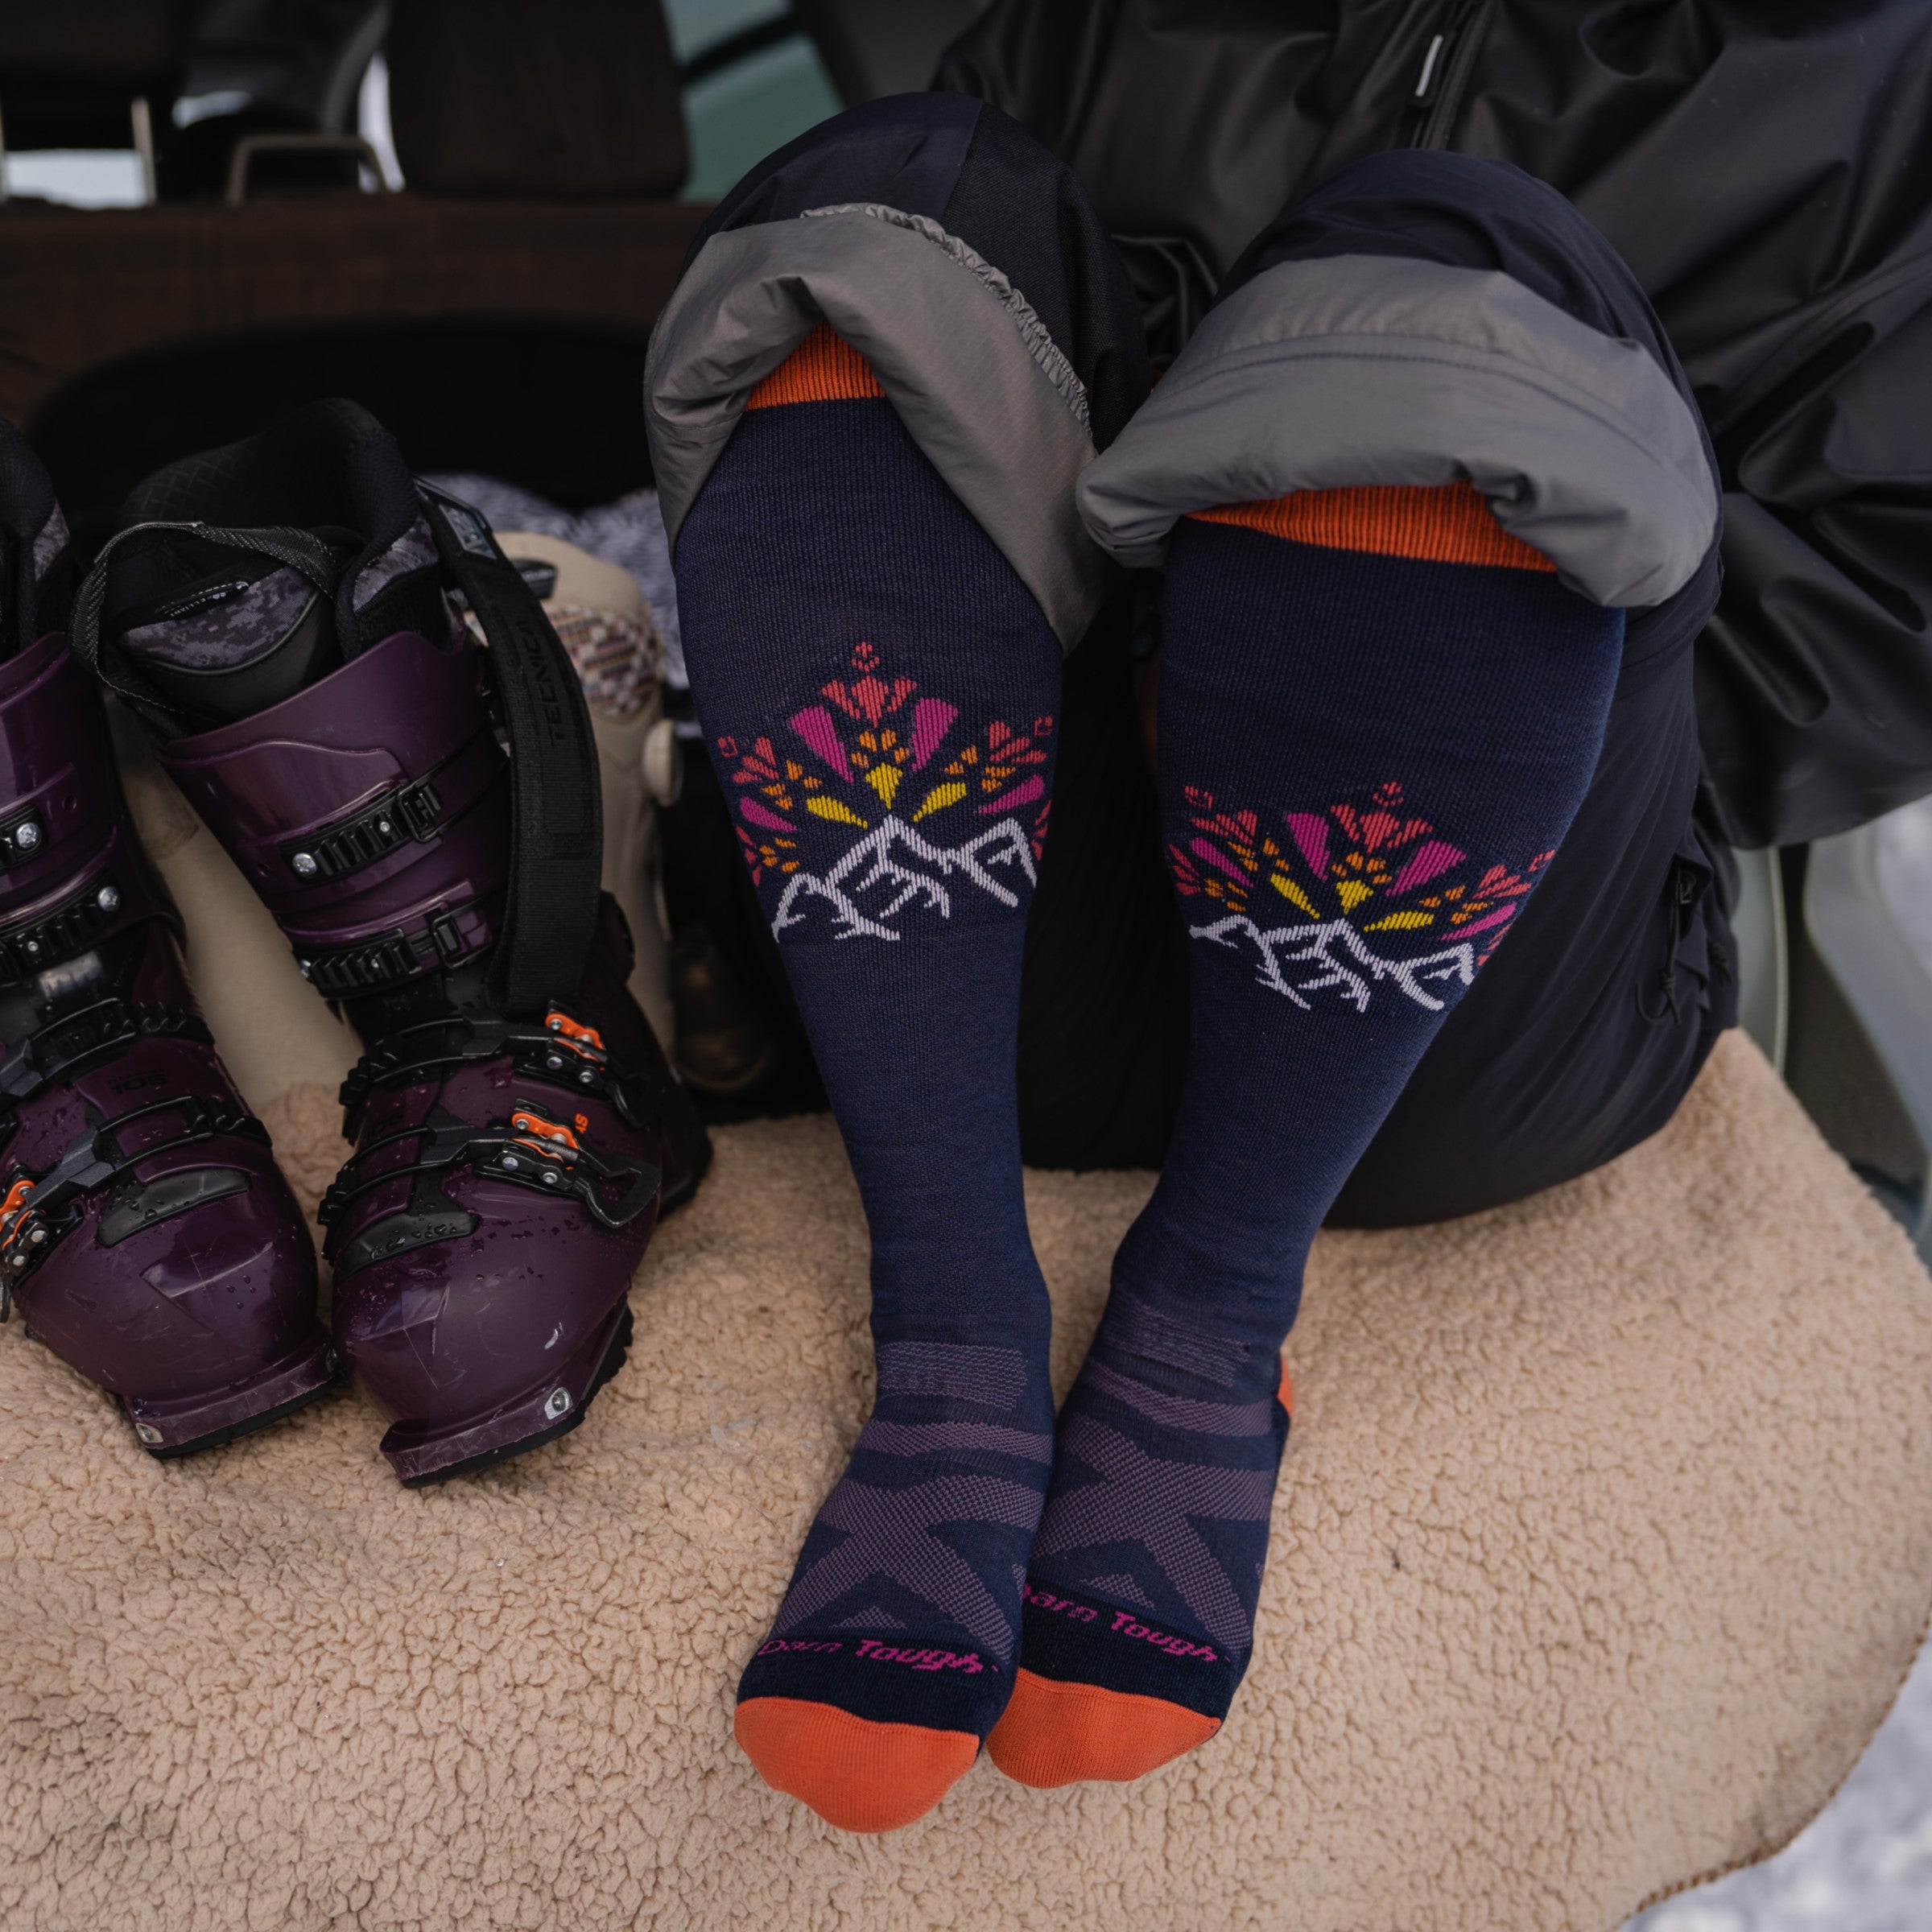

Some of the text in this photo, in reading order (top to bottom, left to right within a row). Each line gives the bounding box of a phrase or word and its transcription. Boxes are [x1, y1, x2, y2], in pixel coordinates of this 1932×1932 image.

[515, 621, 564, 747] TECNICA
[758, 1639, 984, 1673] Darn Tough
[1111, 1611, 1218, 1662] Tough
